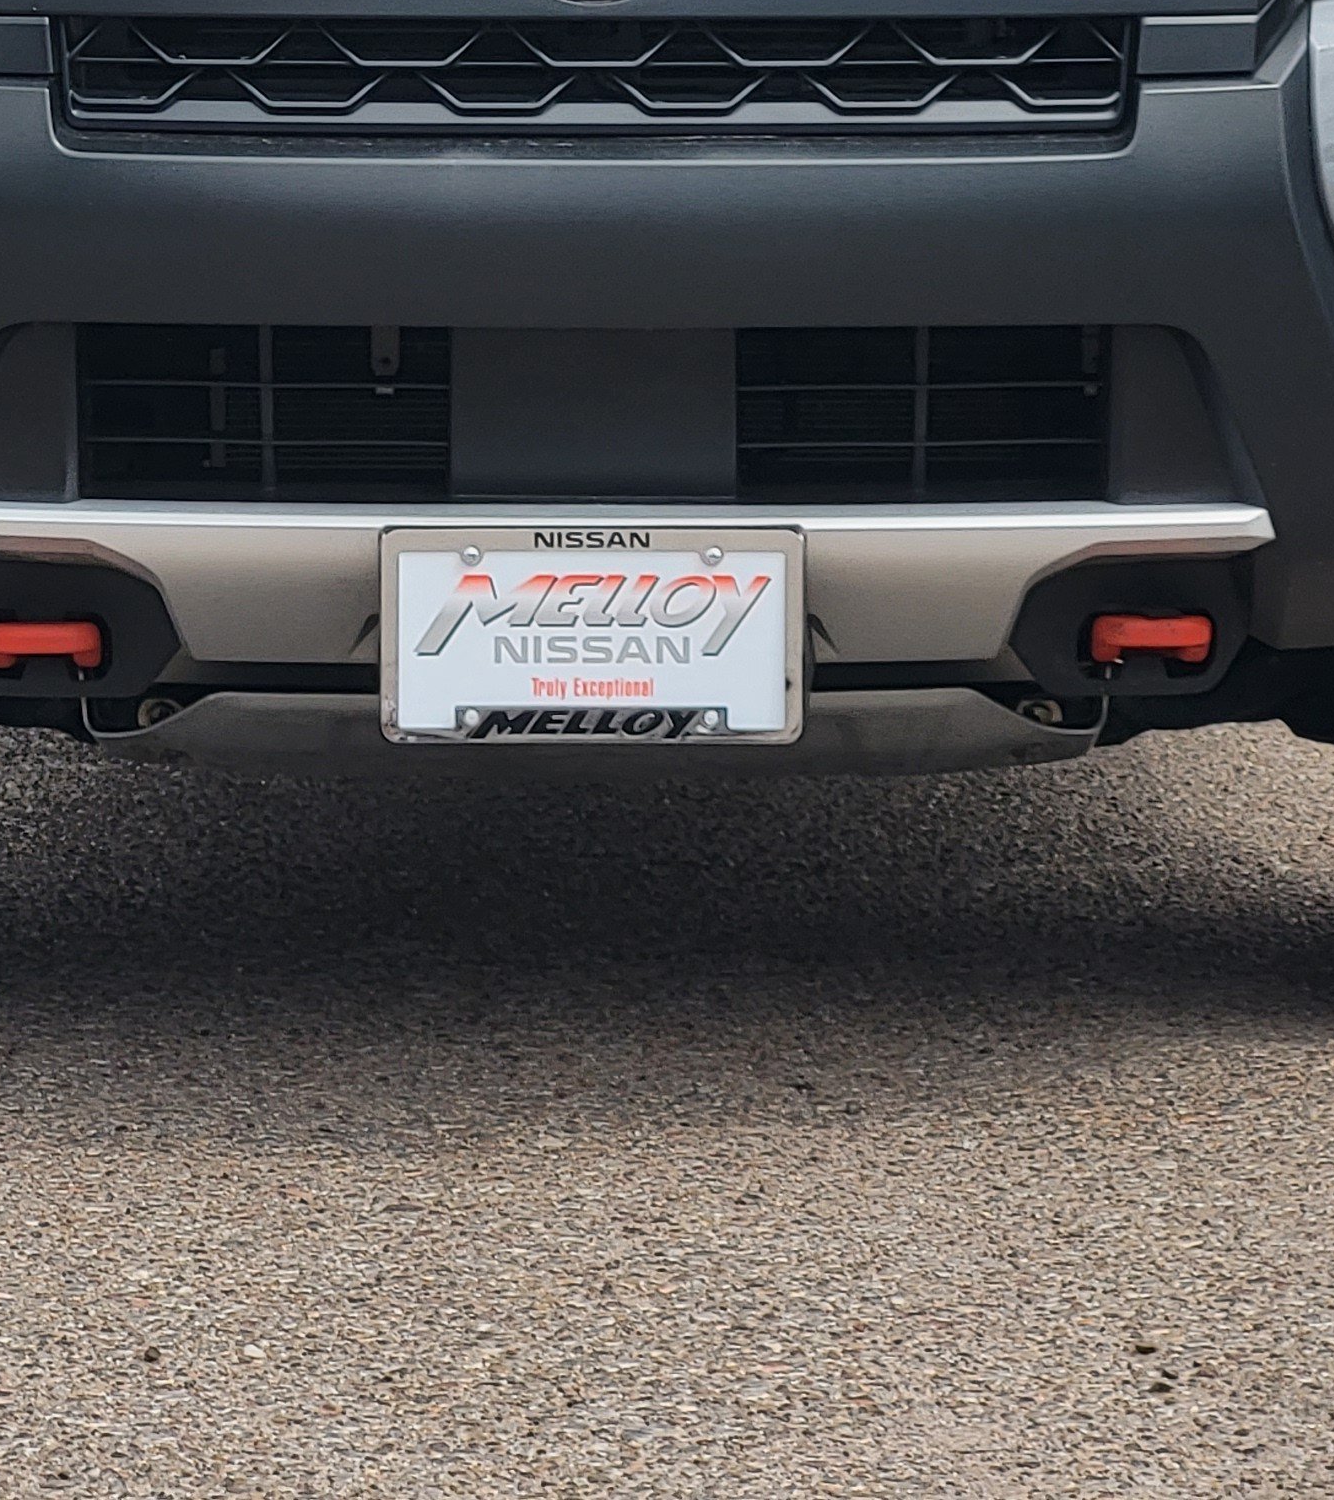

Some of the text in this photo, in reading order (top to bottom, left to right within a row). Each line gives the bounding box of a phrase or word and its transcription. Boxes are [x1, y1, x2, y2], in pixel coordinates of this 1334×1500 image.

[534, 532, 651, 549] NISSAN
[414, 574, 772, 657] MELLOY
[494, 636, 691, 664] NISSAN
[532, 677, 654, 699] Truly Exceptional
[471, 709, 697, 739] MELLOY
